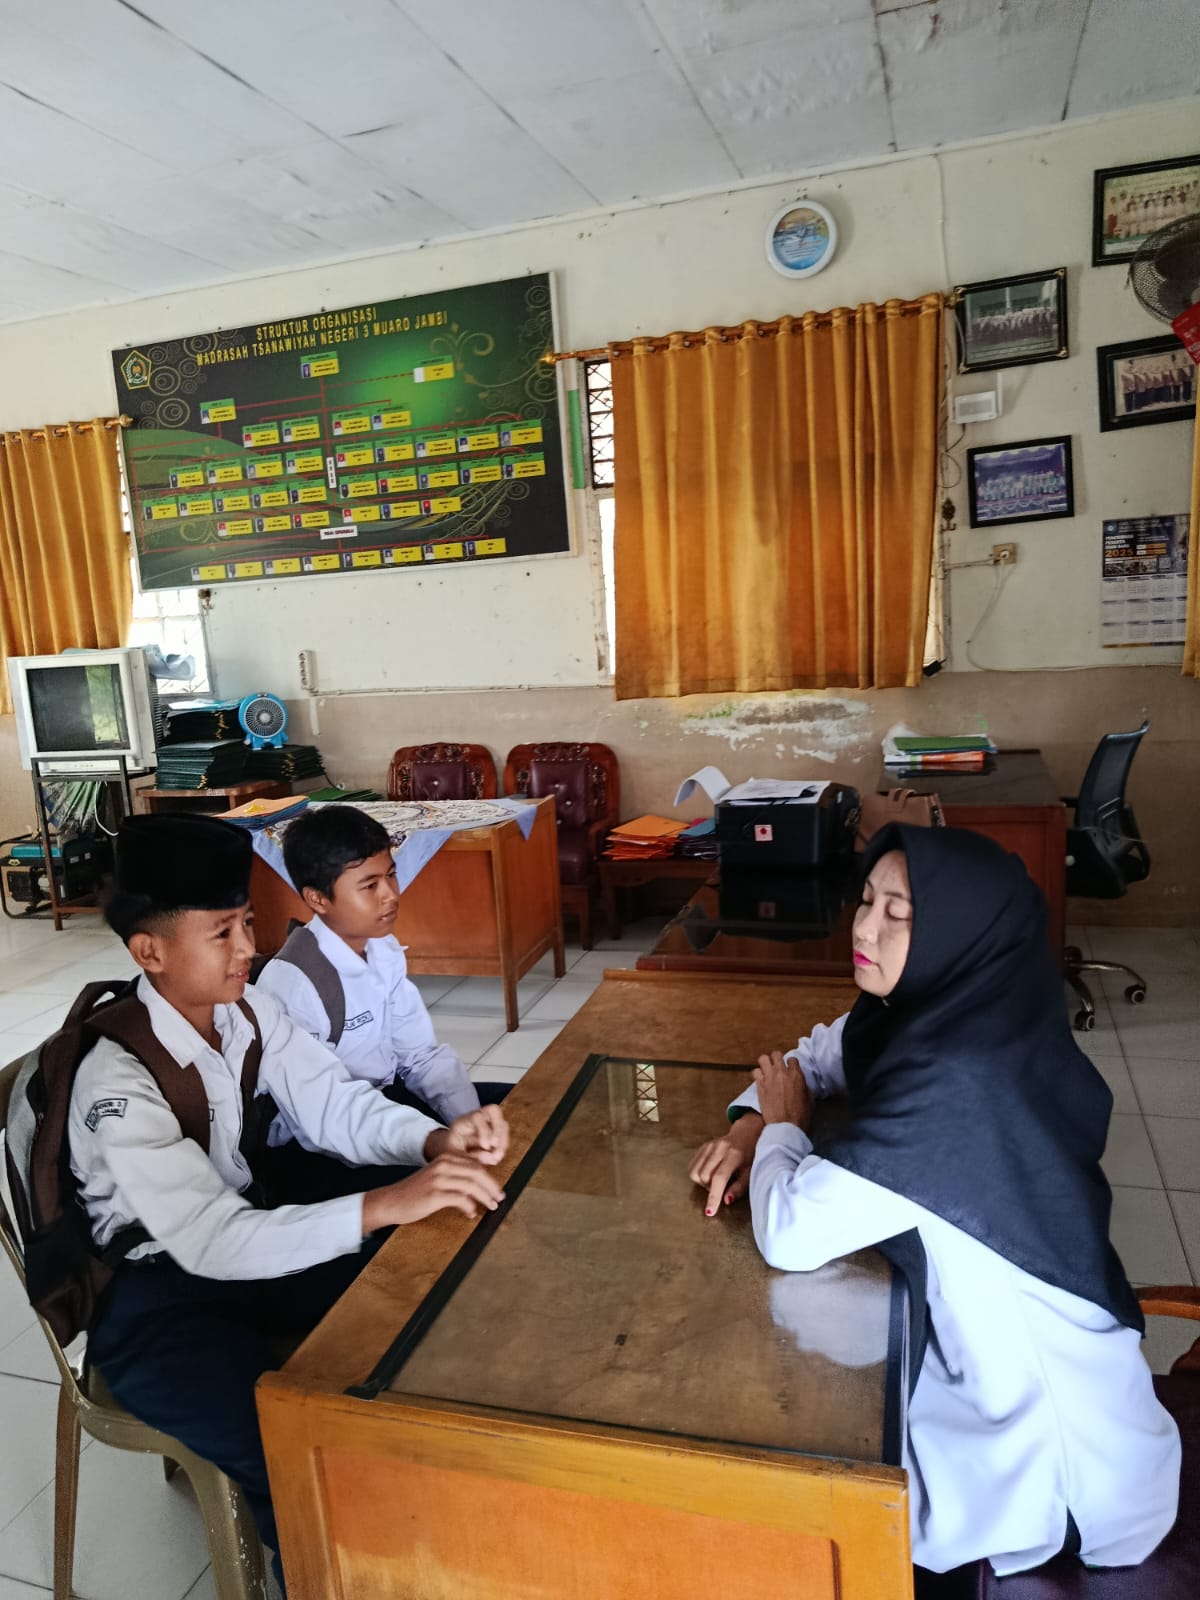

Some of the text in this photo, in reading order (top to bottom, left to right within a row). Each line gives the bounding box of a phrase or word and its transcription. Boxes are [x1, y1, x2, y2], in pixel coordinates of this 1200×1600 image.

[195, 310, 448, 366] MADRASAH TSANAWIYAH NEGERI 3 MUARO JAMBI
[256, 306, 377, 341] STRUKTUR ORGANISASI
[1104, 549, 1134, 557] 2025
